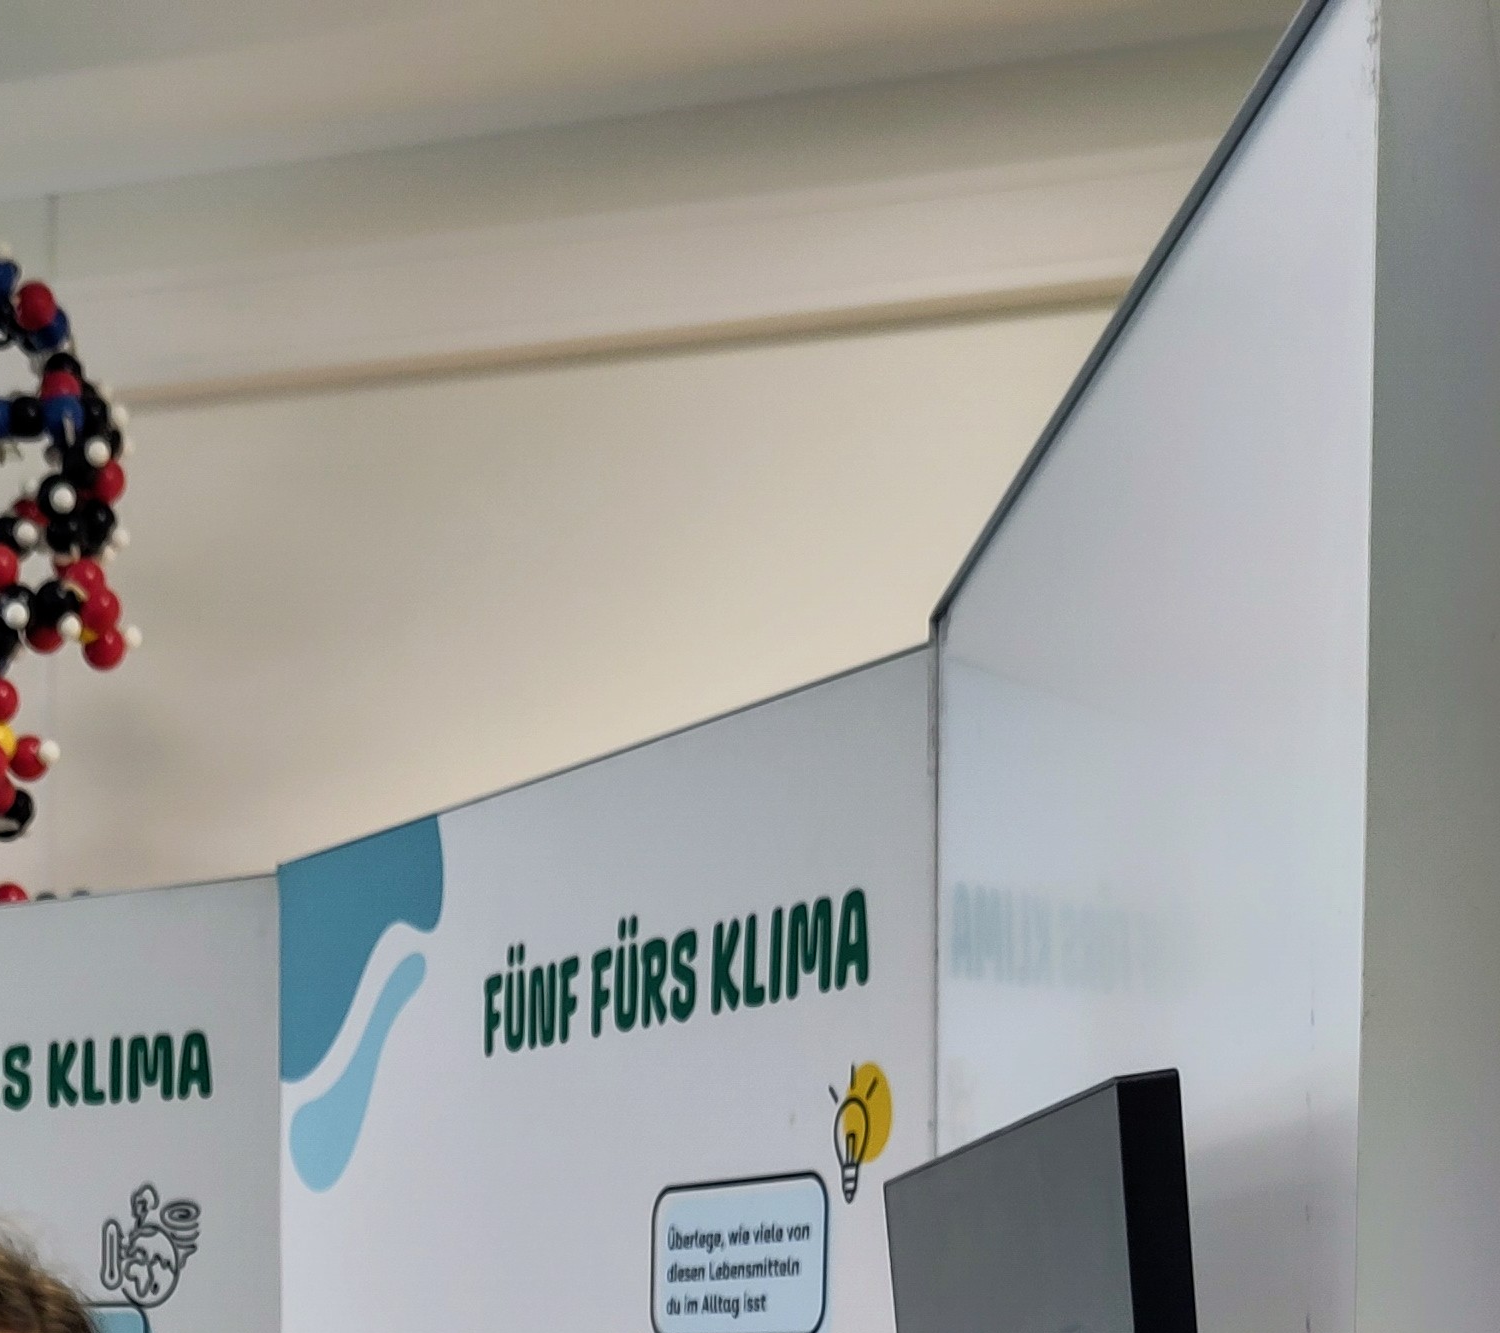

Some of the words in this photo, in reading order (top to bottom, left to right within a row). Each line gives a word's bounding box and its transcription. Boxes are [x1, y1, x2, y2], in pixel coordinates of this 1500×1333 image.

[483, 942, 580, 1058] FÜNF
[590, 915, 699, 1038] FÜRS
[711, 887, 870, 1015] KLIMA
[47, 1029, 214, 1109] KLIMA
[728, 1224, 750, 1246] wie
[753, 1223, 784, 1244] viele
[787, 1223, 811, 1242] von
[666, 1262, 705, 1283] diesen
[708, 1257, 800, 1281] Lebensmitteln
[666, 1296, 680, 1315] du
[684, 1294, 698, 1314] im
[702, 1293, 740, 1319] Alltag
[743, 1292, 767, 1313] isst
